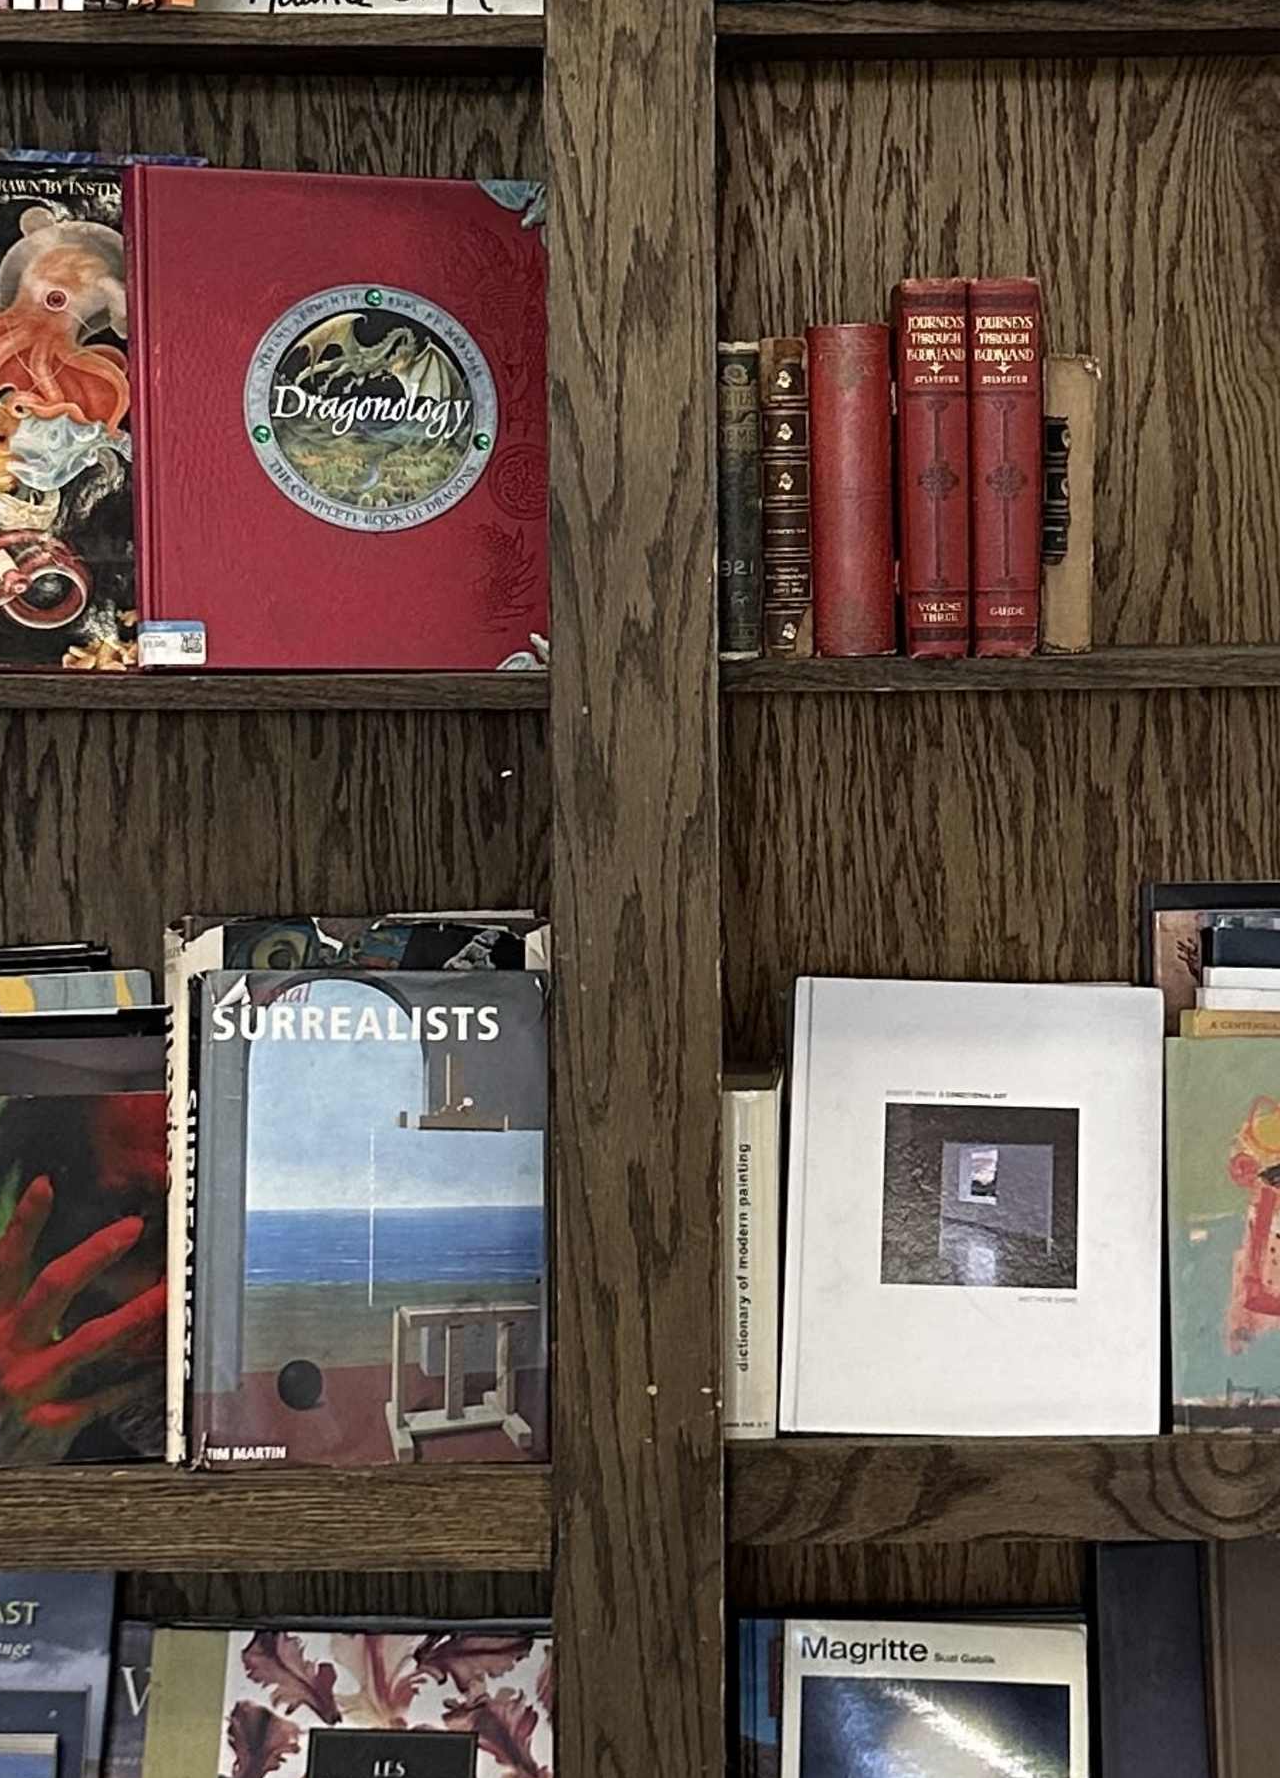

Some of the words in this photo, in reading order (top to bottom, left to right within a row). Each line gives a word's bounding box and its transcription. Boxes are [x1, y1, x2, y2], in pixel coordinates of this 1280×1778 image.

[45, 179, 65, 195] BY
[907, 316, 966, 333] JOURNEYS
[975, 316, 1034, 334] JOURNEYS
[910, 332, 962, 345] THROUGH
[978, 332, 1030, 345] THROUGH
[906, 348, 967, 362] BOOKLAND
[974, 348, 1035, 362] BOOKLAND
[271, 383, 472, 439] Dragonology
[423, 465, 479, 514] DRAGONS
[211, 1004, 500, 1043] SURREALISTS
[738, 1142, 752, 1209] painting
[738, 1212, 750, 1270] modern
[738, 1275, 750, 1291] of
[738, 1294, 751, 1372] dictionary
[206, 1447, 230, 1461] TIM
[232, 1446, 286, 1461] MARTIN
[801, 1635, 929, 1665] Magritte
[373, 1760, 406, 1778] LES
